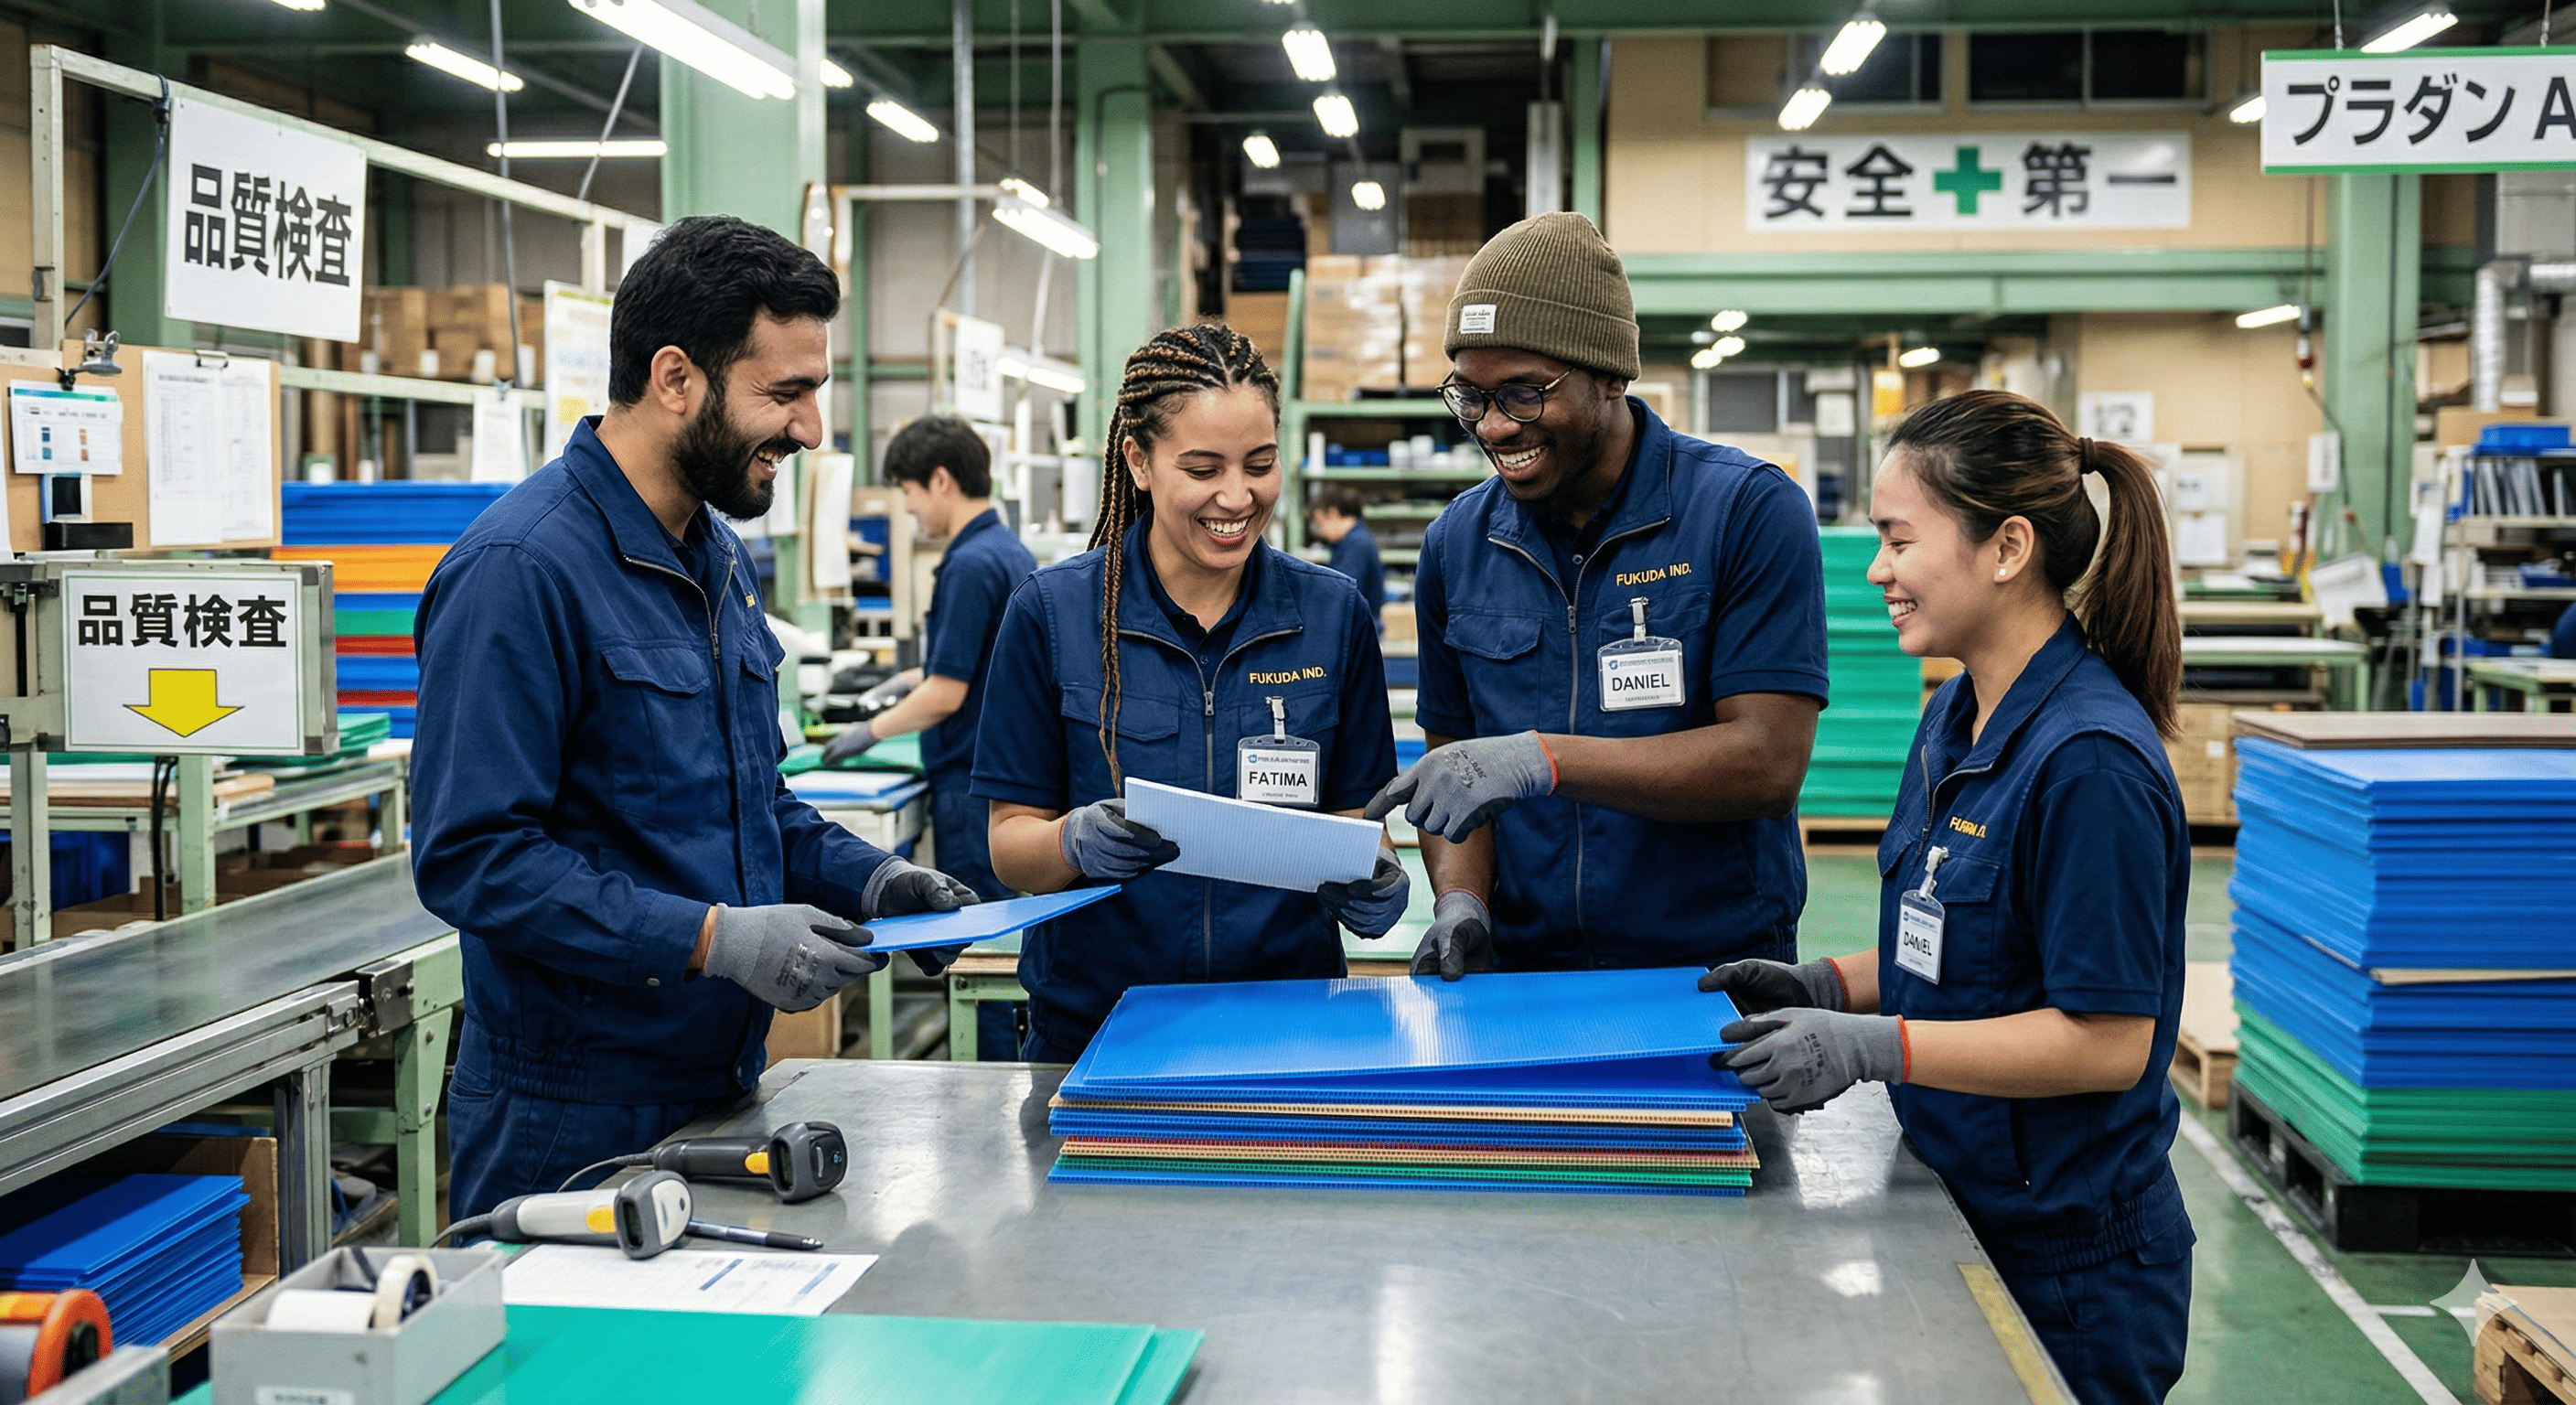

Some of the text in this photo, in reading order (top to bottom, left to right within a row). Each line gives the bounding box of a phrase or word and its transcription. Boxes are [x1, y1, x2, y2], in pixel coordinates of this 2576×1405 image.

[2288, 73, 2576, 145] プラダン A
[1762, 140, 2177, 219] 安全 第一
[185, 163, 352, 287] 品質検査
[1615, 563, 1692, 586] FUKUDA IND.
[78, 593, 286, 648] 品質検査
[1249, 666, 1326, 684] FUKUDA IND.
[1612, 673, 1670, 692] DANIEL
[1249, 771, 1308, 788] FATIMA
